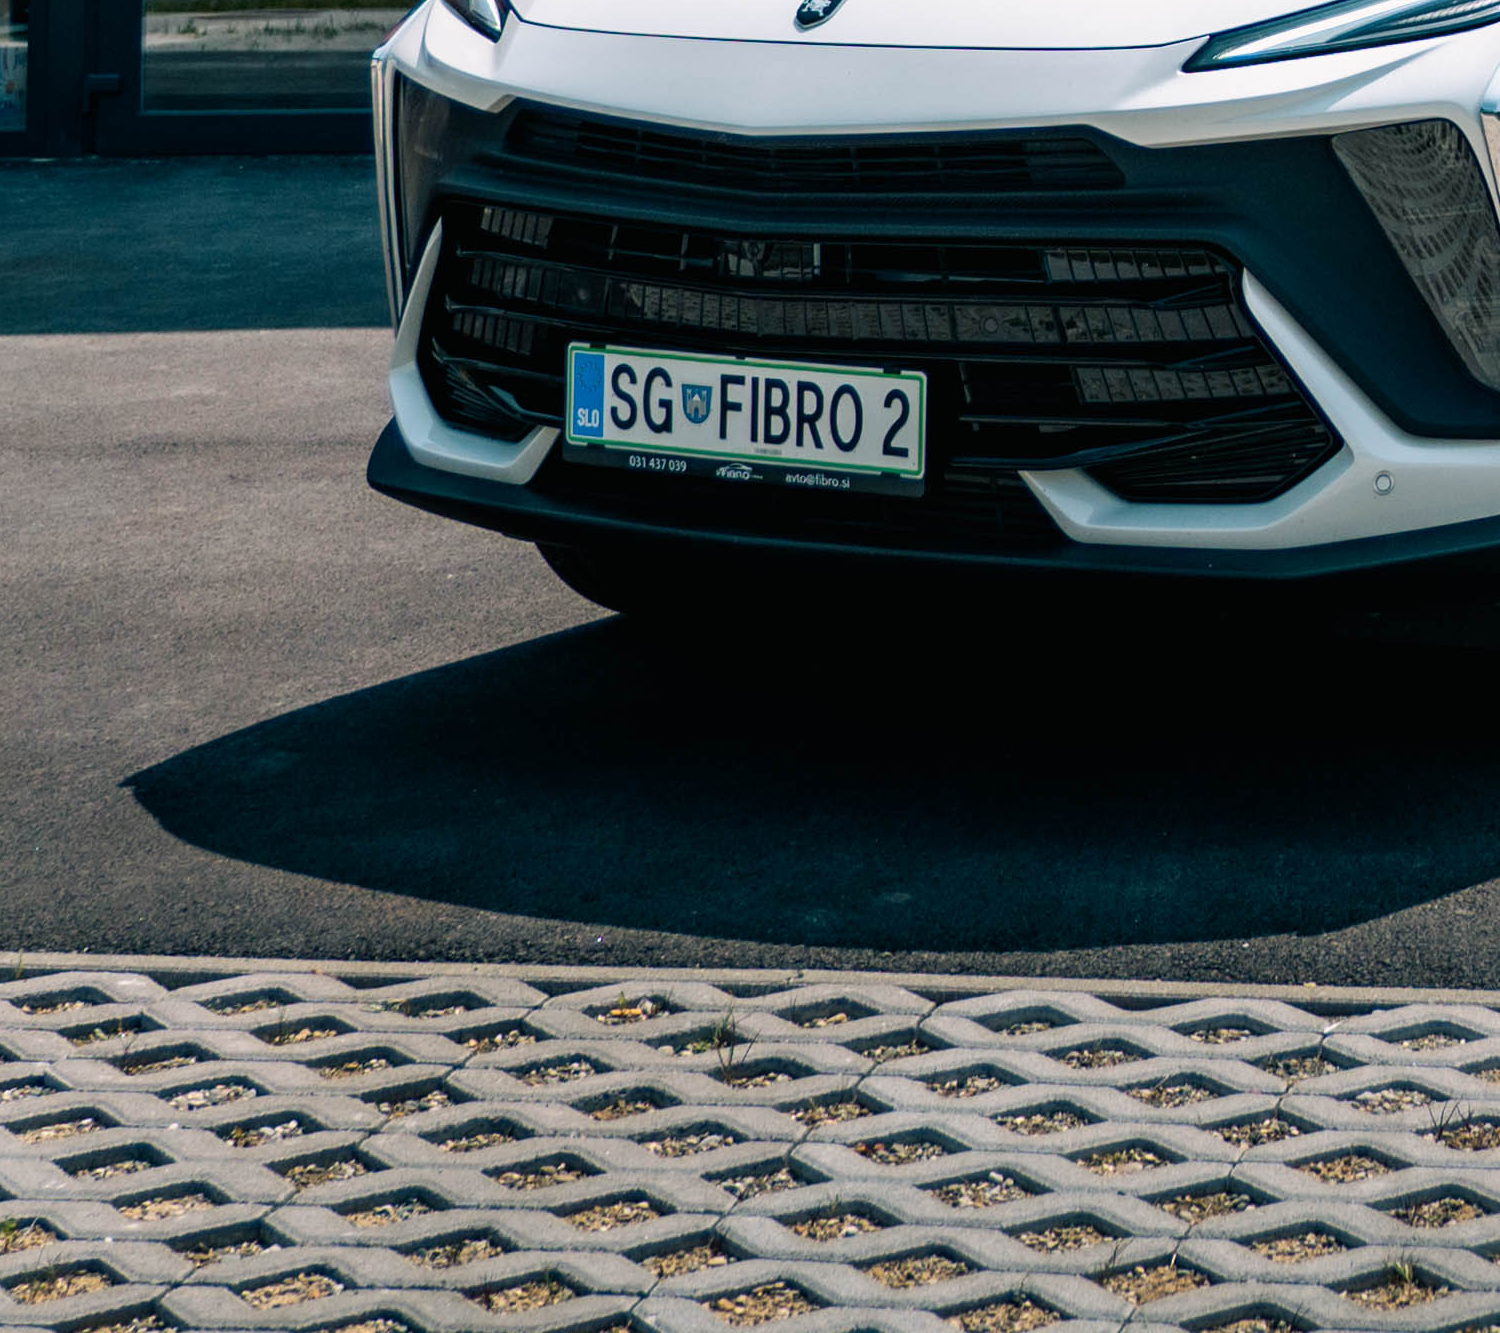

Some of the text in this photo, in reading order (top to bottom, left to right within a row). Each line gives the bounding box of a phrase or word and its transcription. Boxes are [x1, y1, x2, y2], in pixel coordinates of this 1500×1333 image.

[577, 408, 600, 429] SLO
[609, 363, 911, 459] SG FIBRO 2
[628, 454, 688, 473] 031 437 039
[785, 473, 851, 489] avto@fibro.si
